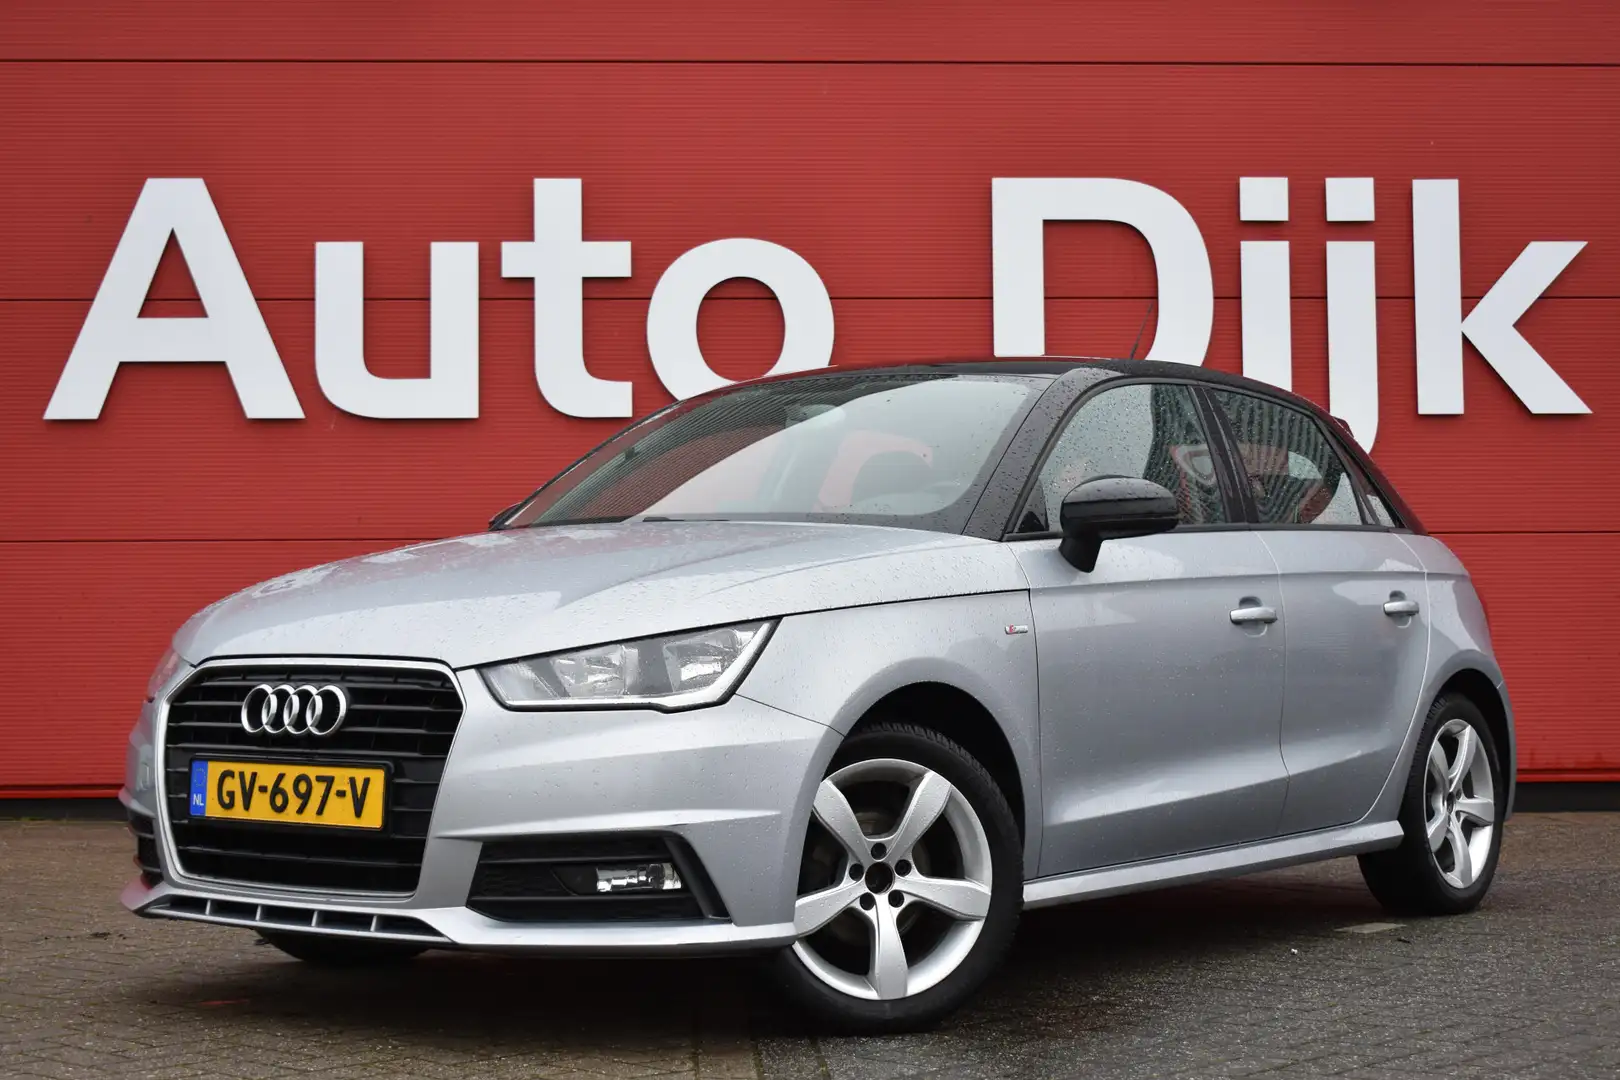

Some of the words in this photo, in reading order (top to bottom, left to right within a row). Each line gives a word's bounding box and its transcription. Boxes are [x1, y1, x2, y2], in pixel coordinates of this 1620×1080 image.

[43, 178, 834, 420] Auto
[992, 177, 1593, 454] Dijk
[193, 794, 204, 806] NL
[217, 769, 371, 818] GV-697-V
